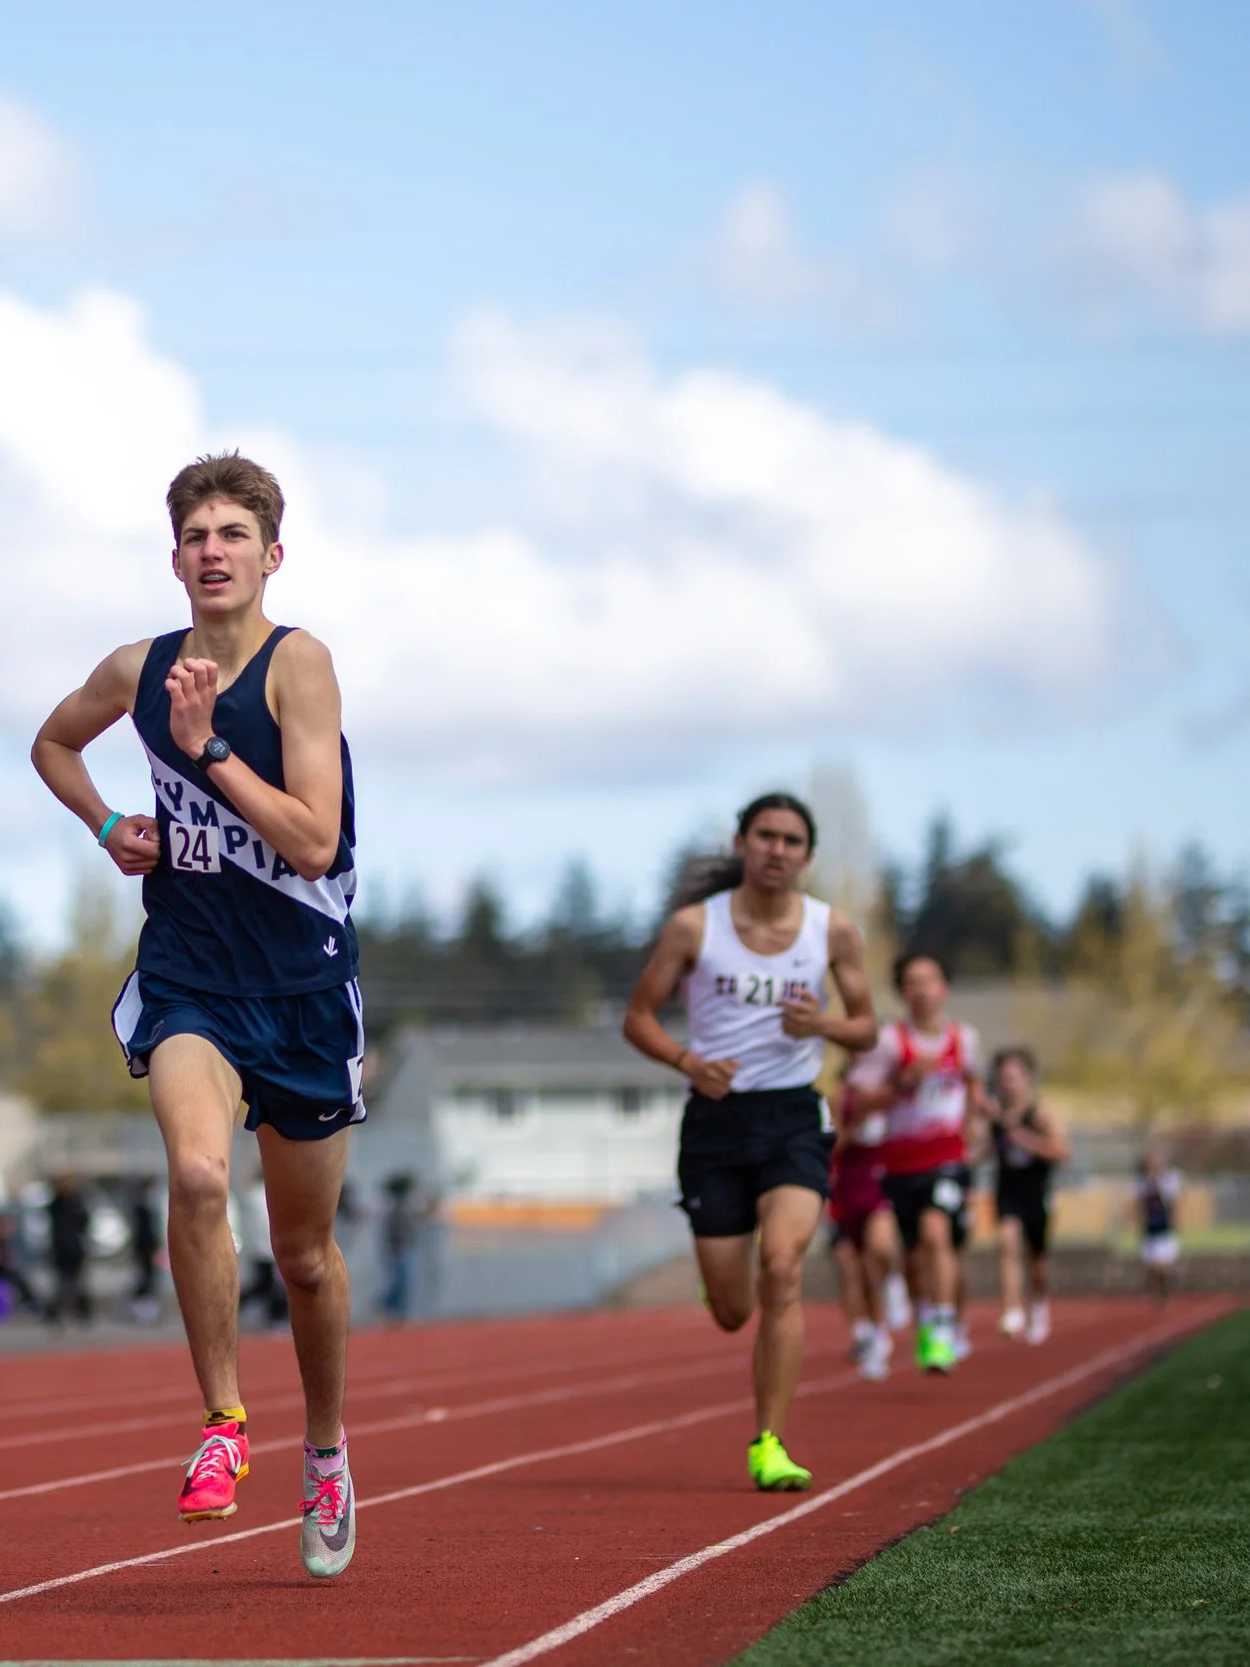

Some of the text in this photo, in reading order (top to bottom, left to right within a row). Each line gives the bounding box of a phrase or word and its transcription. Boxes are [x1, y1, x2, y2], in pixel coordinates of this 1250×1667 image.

[154, 778, 298, 880] YMPIA
[176, 826, 212, 870] 24
[745, 974, 774, 1005] 21
